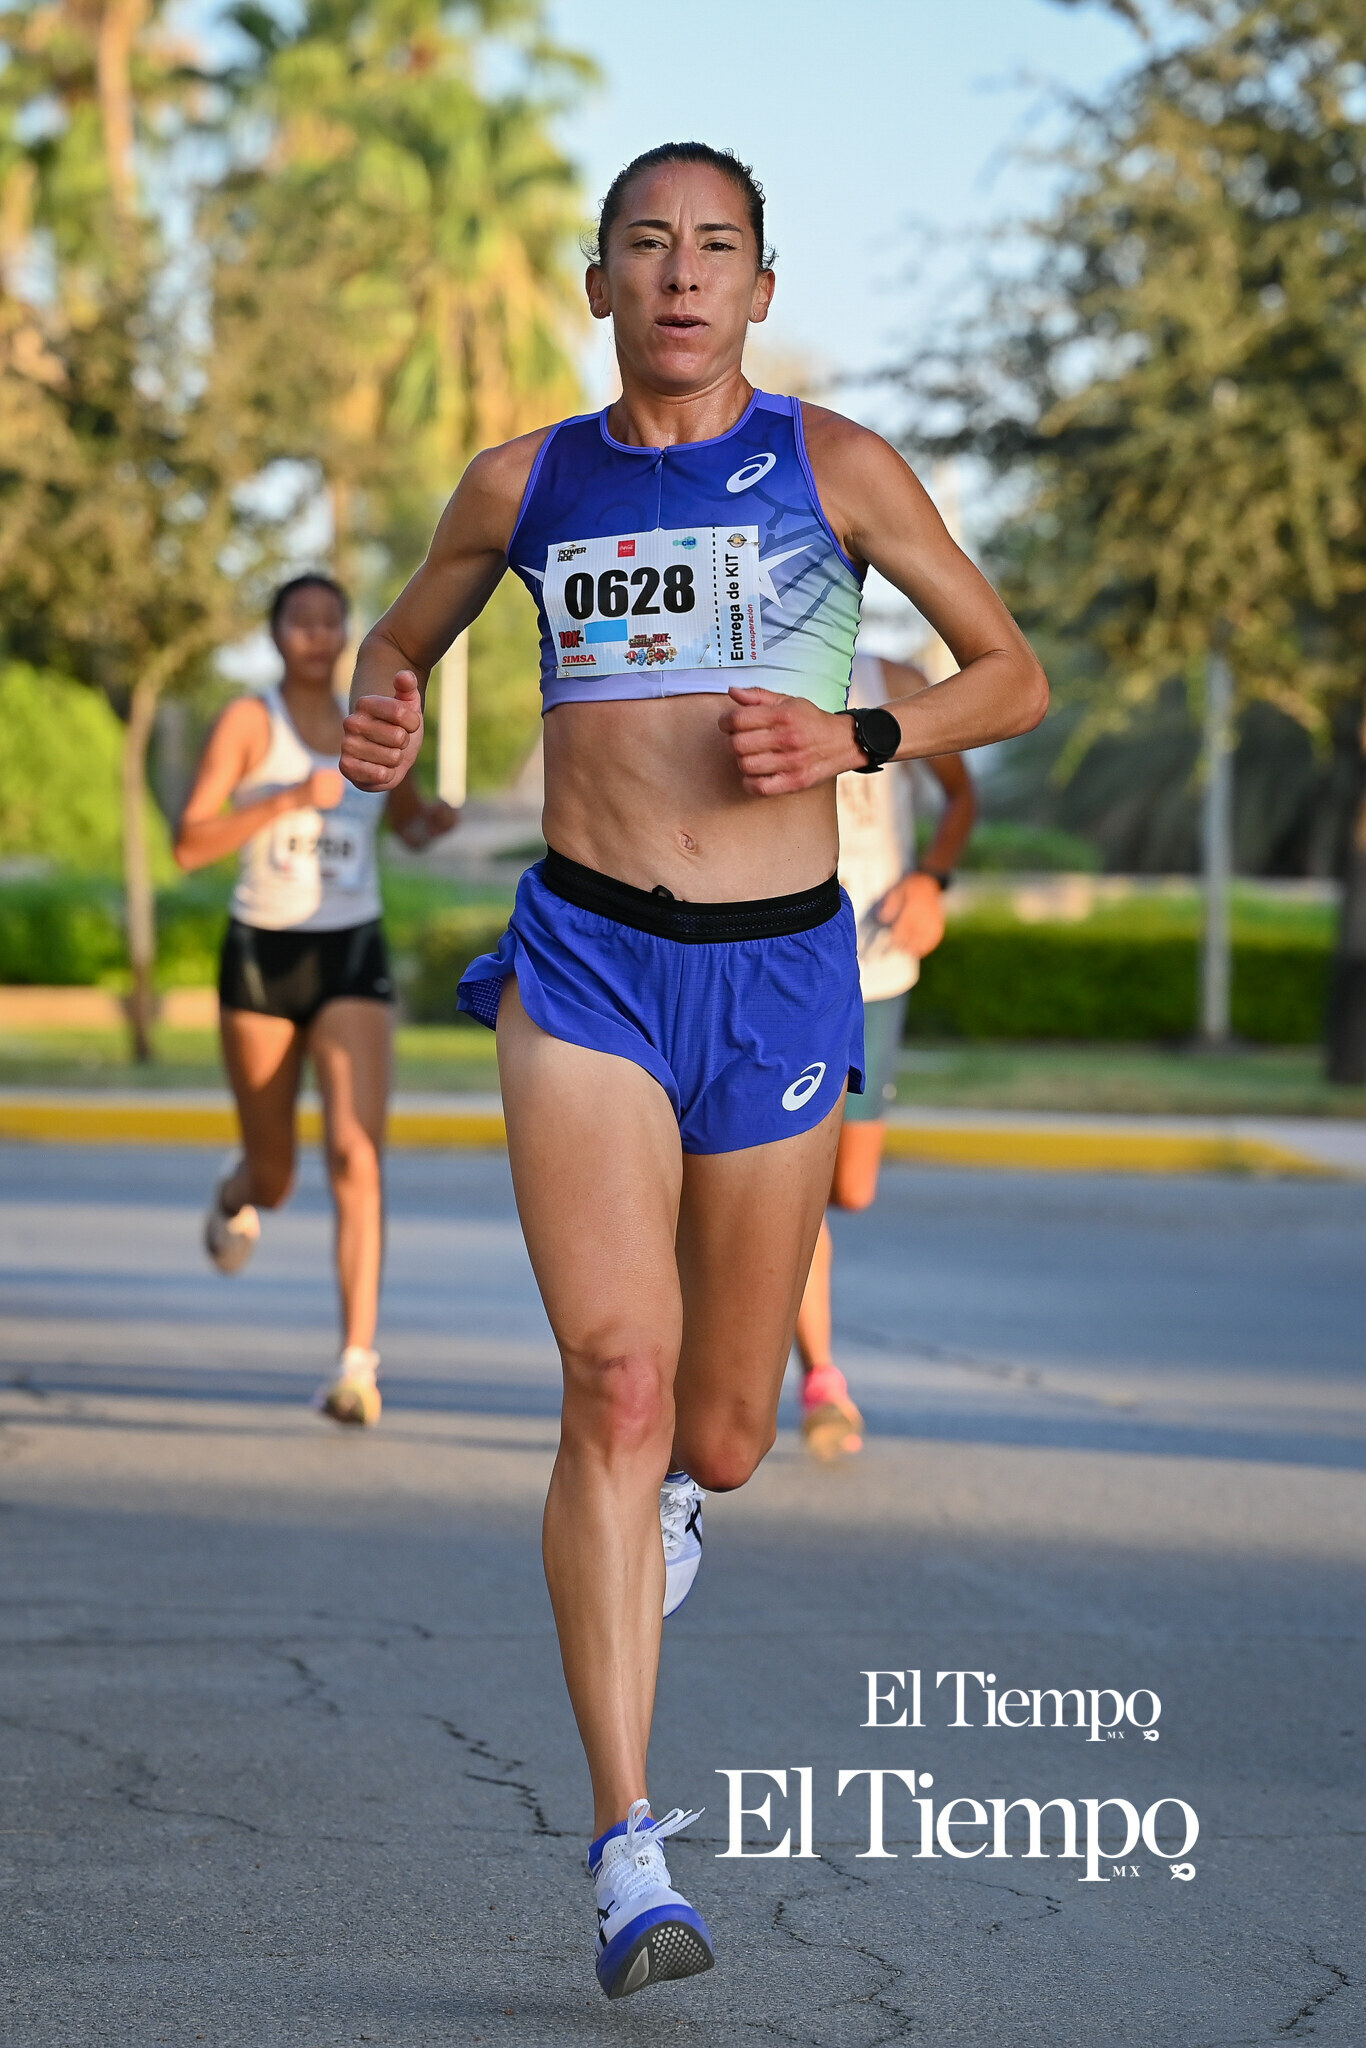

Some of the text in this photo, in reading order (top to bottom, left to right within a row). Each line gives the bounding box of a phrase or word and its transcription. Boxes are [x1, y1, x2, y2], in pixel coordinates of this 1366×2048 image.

[558, 547, 587, 557] POWER
[564, 564, 695, 620] 0628
[725, 553, 744, 661] Entrega de KIT
[747, 604, 757, 650] recuperación
[562, 654, 596, 664] SIMSA
